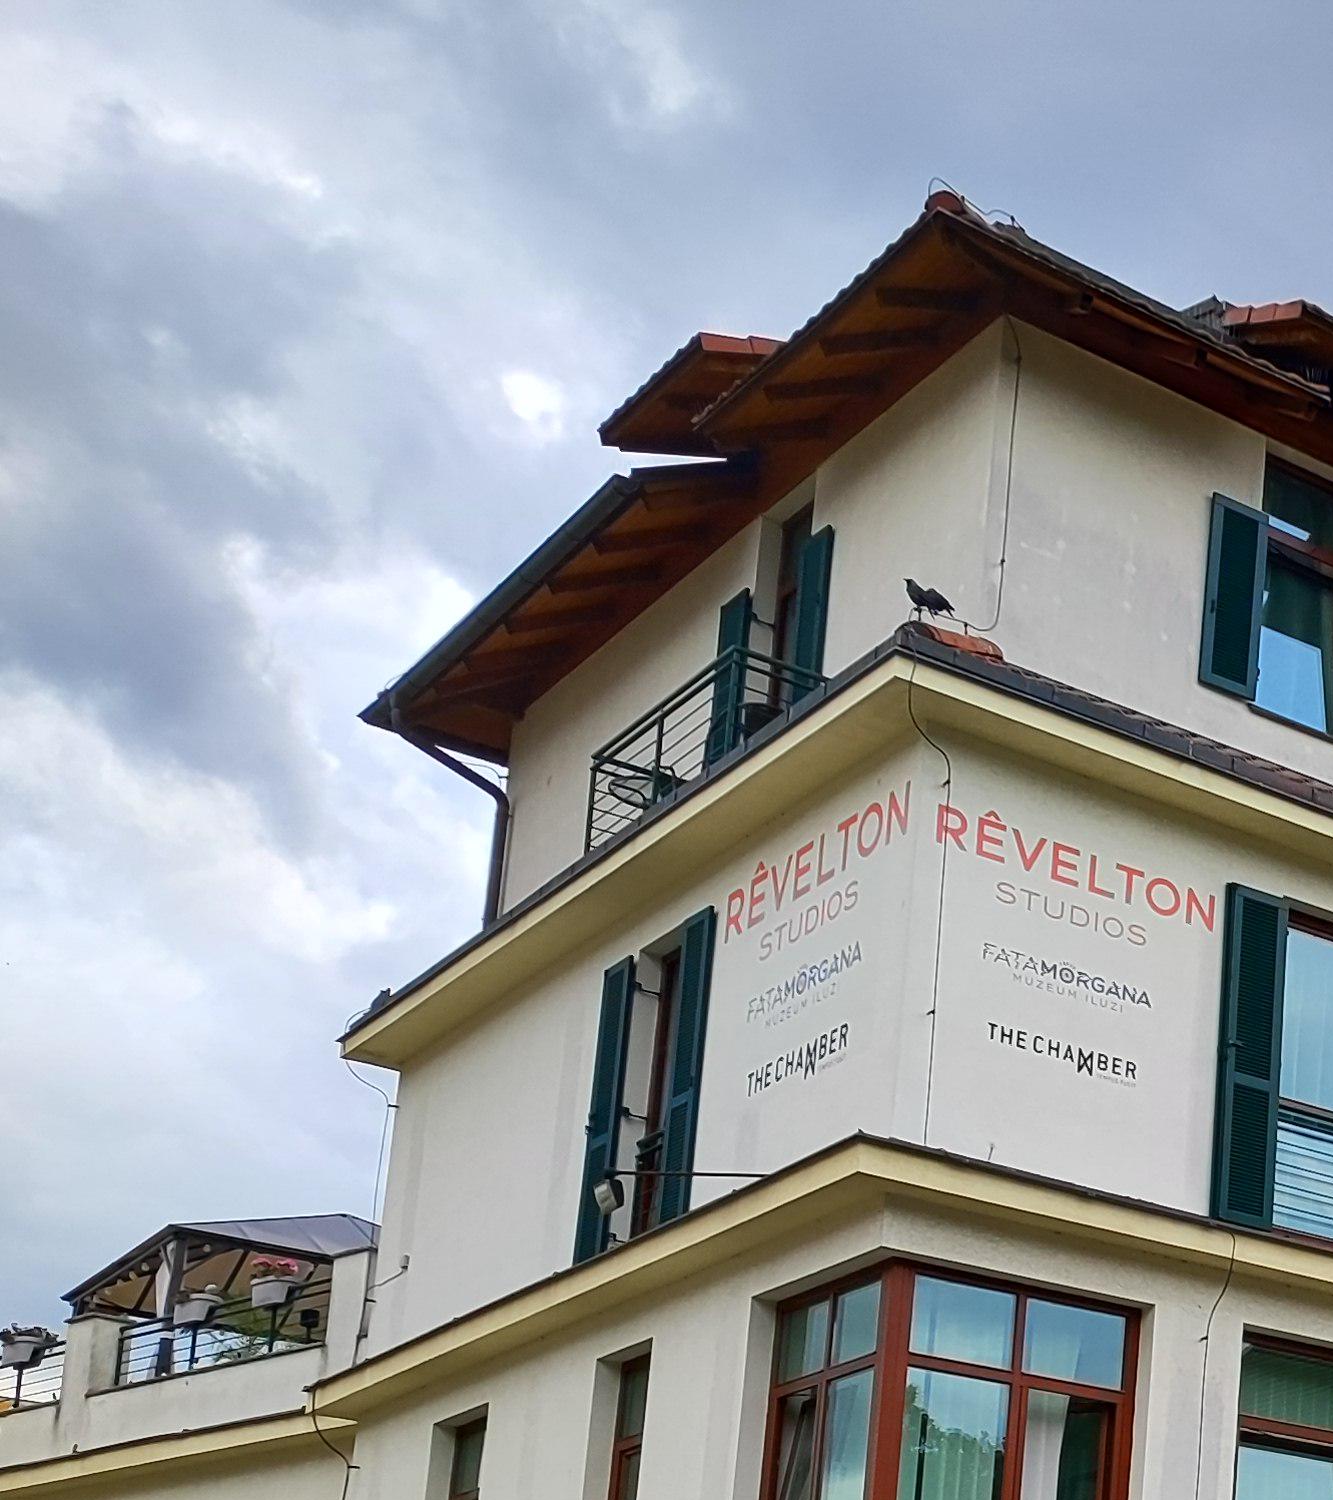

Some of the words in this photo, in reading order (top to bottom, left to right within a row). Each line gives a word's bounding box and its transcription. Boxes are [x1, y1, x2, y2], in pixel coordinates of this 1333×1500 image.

[724, 780, 911, 944] RÊVELTON
[935, 803, 1216, 933] RÊVELTON
[758, 880, 859, 962] STUDIOS
[995, 881, 1147, 947] STUDIOS
[1012, 972, 1077, 999] MUZEUM
